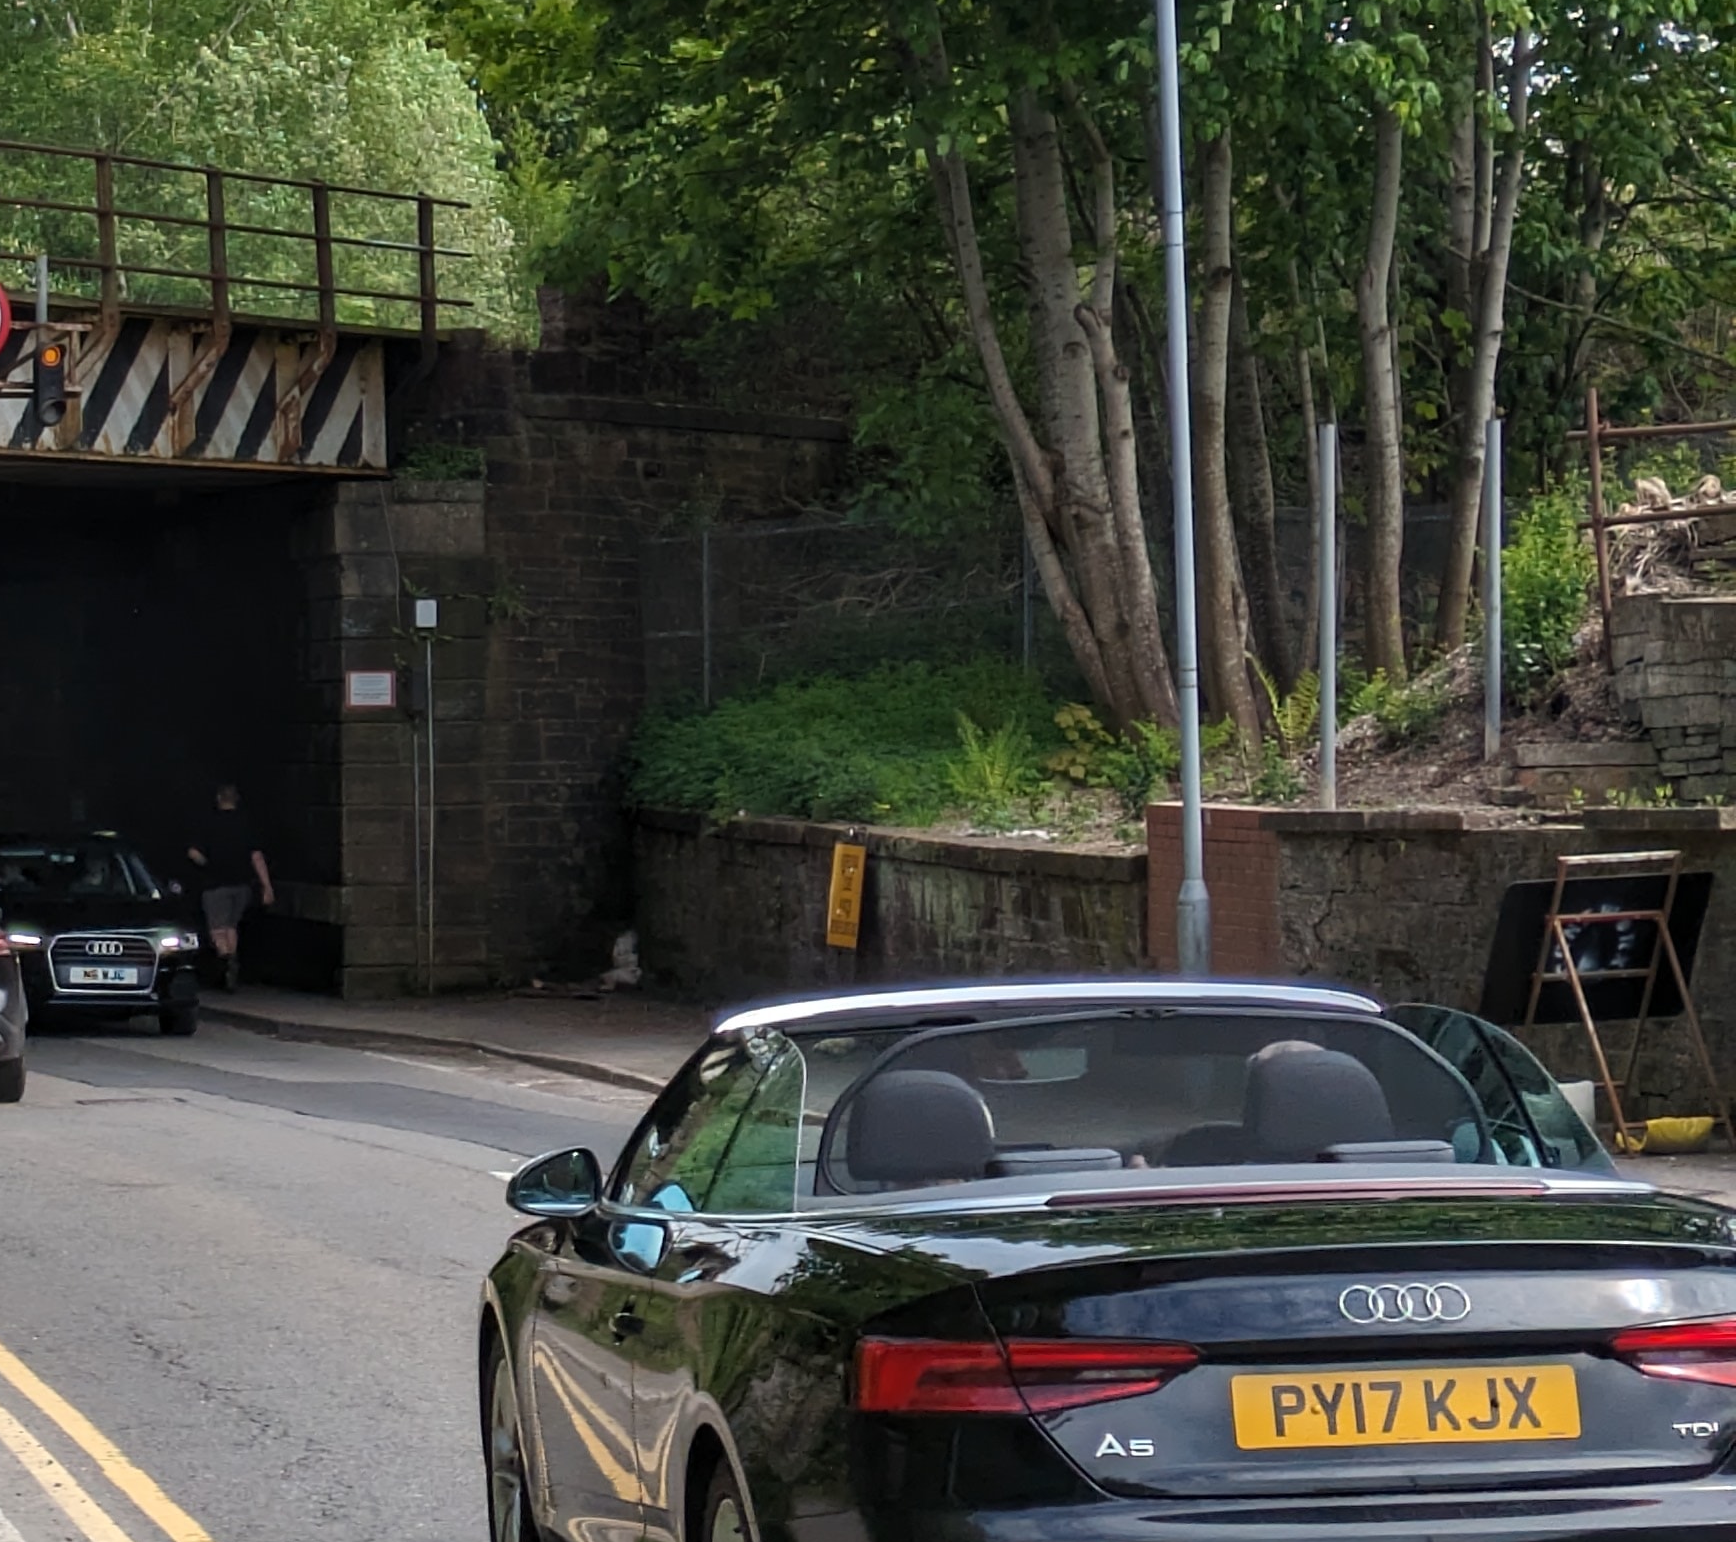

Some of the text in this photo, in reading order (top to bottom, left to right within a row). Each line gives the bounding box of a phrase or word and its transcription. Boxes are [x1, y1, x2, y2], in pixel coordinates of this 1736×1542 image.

[1271, 1377, 1542, 1438] PY17 KJX
[1672, 1421, 1719, 1437] TDI
[1095, 1433, 1155, 1458] A5
